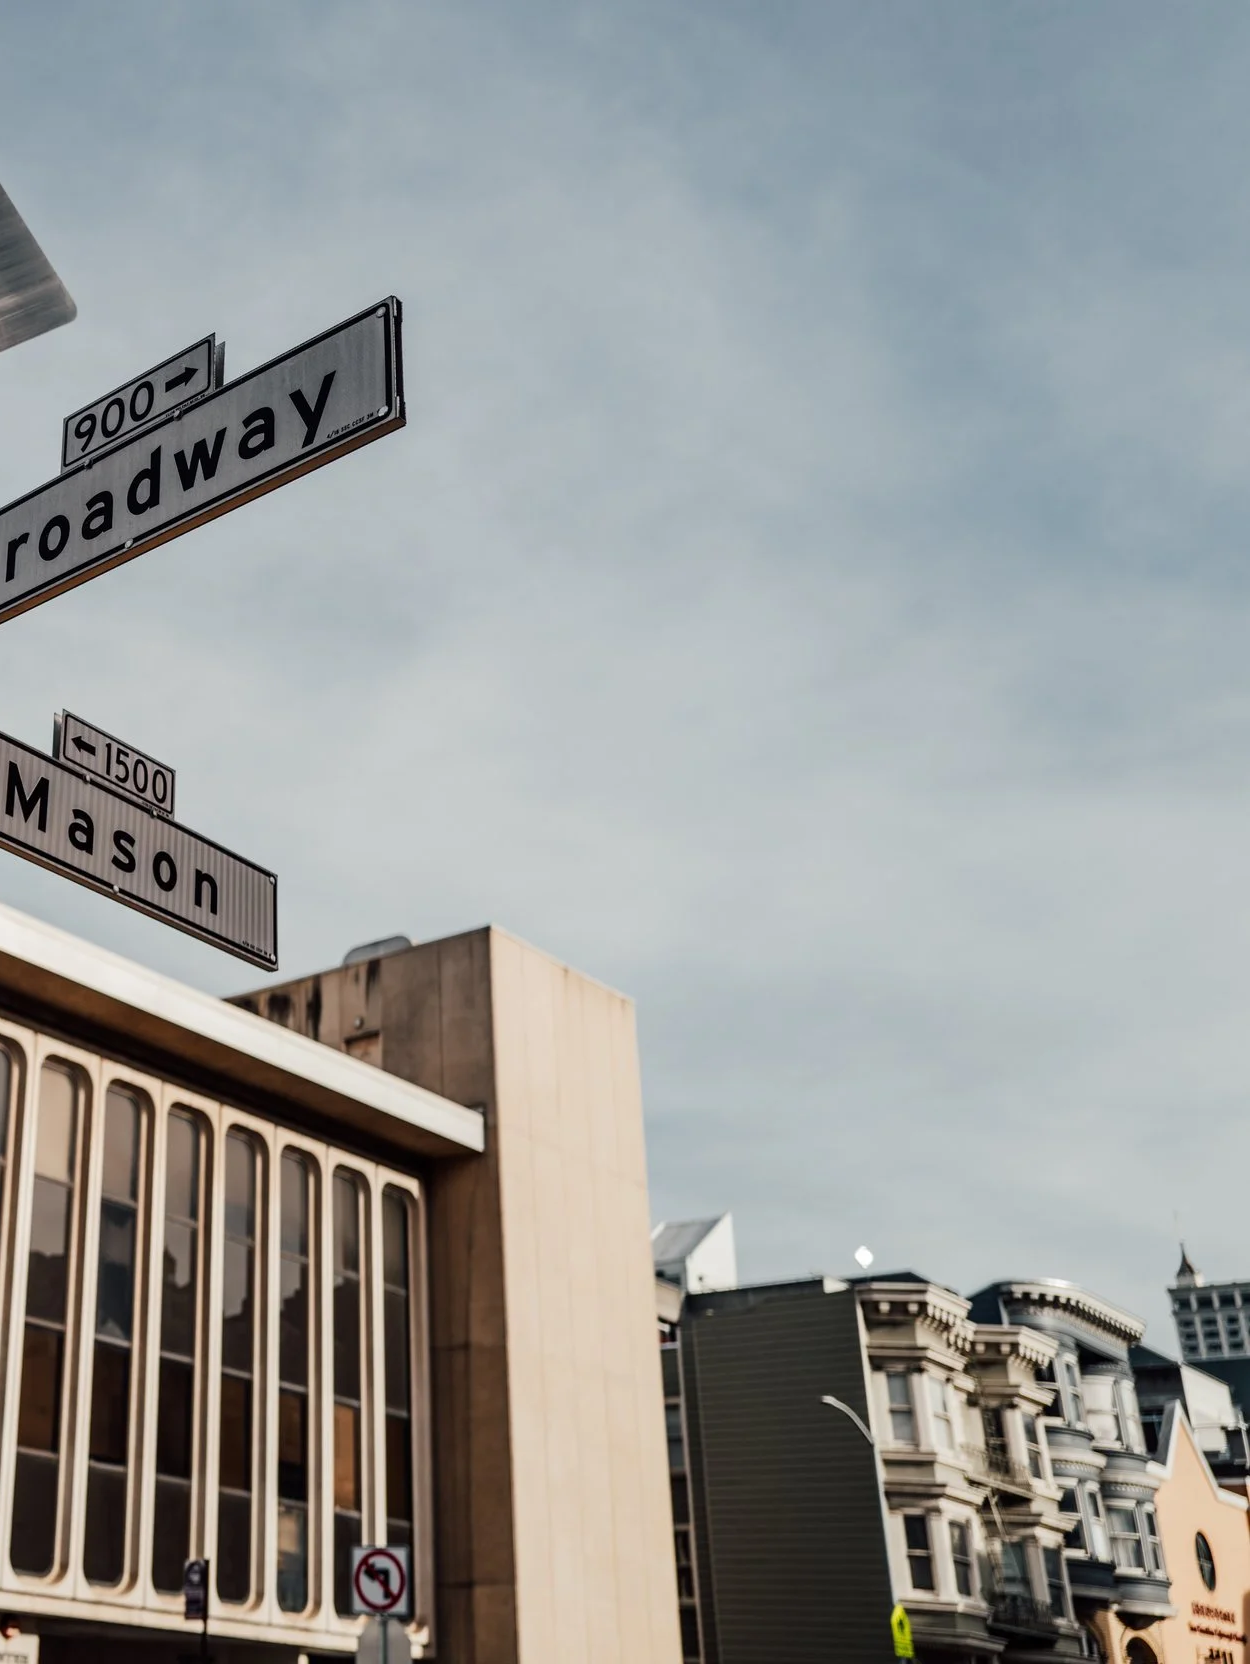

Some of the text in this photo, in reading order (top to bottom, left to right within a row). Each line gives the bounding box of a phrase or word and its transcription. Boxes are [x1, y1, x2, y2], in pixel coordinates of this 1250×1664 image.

[74, 381, 155, 453] 900
[104, 742, 168, 805] 1500
[4, 760, 219, 916] Mason
